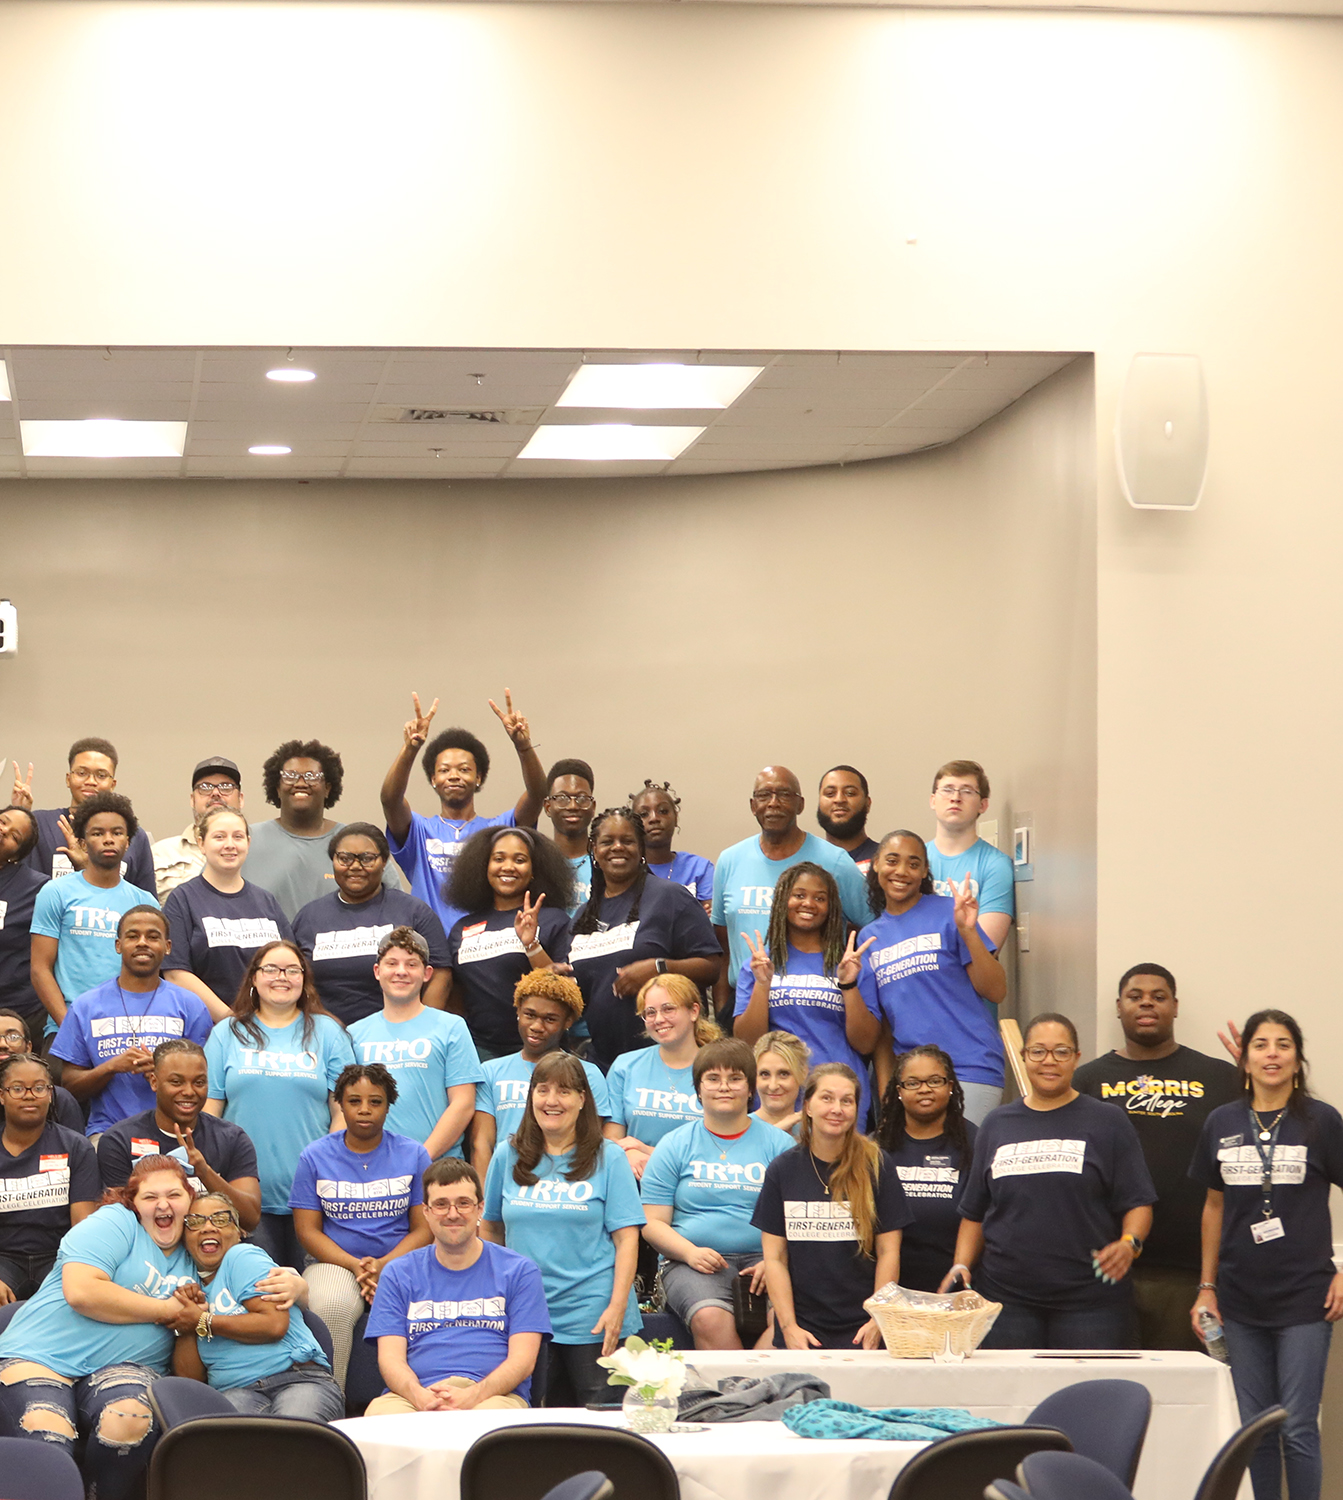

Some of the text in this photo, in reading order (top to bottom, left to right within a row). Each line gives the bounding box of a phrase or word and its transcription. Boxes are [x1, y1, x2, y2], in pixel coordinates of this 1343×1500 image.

[740, 886, 774, 907] TR
[69, 905, 121, 931] TRI
[94, 931, 116, 939] SUPPORT
[317, 940, 378, 952] FIRST-GENERAT
[460, 938, 522, 954] FIRST-GENERAT
[875, 953, 937, 981] ST-GENERATION
[877, 964, 939, 988] LEGE CELEBRATION
[768, 988, 844, 1005] RST-GENERATIO
[97, 1035, 174, 1050] FIRST-GENERAT
[360, 1038, 432, 1062] TRIO
[98, 1047, 130, 1058] COLLEG
[404, 1061, 428, 1069] SERVICES
[238, 1068, 318, 1079] STUDENT SUPPORT SERVICES
[496, 1080, 531, 1101] TR
[1101, 1079, 1204, 1099] MORRIS
[1125, 1093, 1187, 1119] College
[994, 1156, 1078, 1168] FIRST-GENERATION
[688, 1181, 712, 1189] STUDENT
[742, 1184, 763, 1192] SERVIC
[23, 1196, 68, 1207] CELEBRATION
[320, 1195, 410, 1213] FIRST-GENERATION
[510, 1200, 588, 1211] STUDENT SUPPORT SERVICES
[788, 1221, 855, 1231] FIRST-GENERAT
[787, 1231, 855, 1239] COLLEGE CELEBRA
